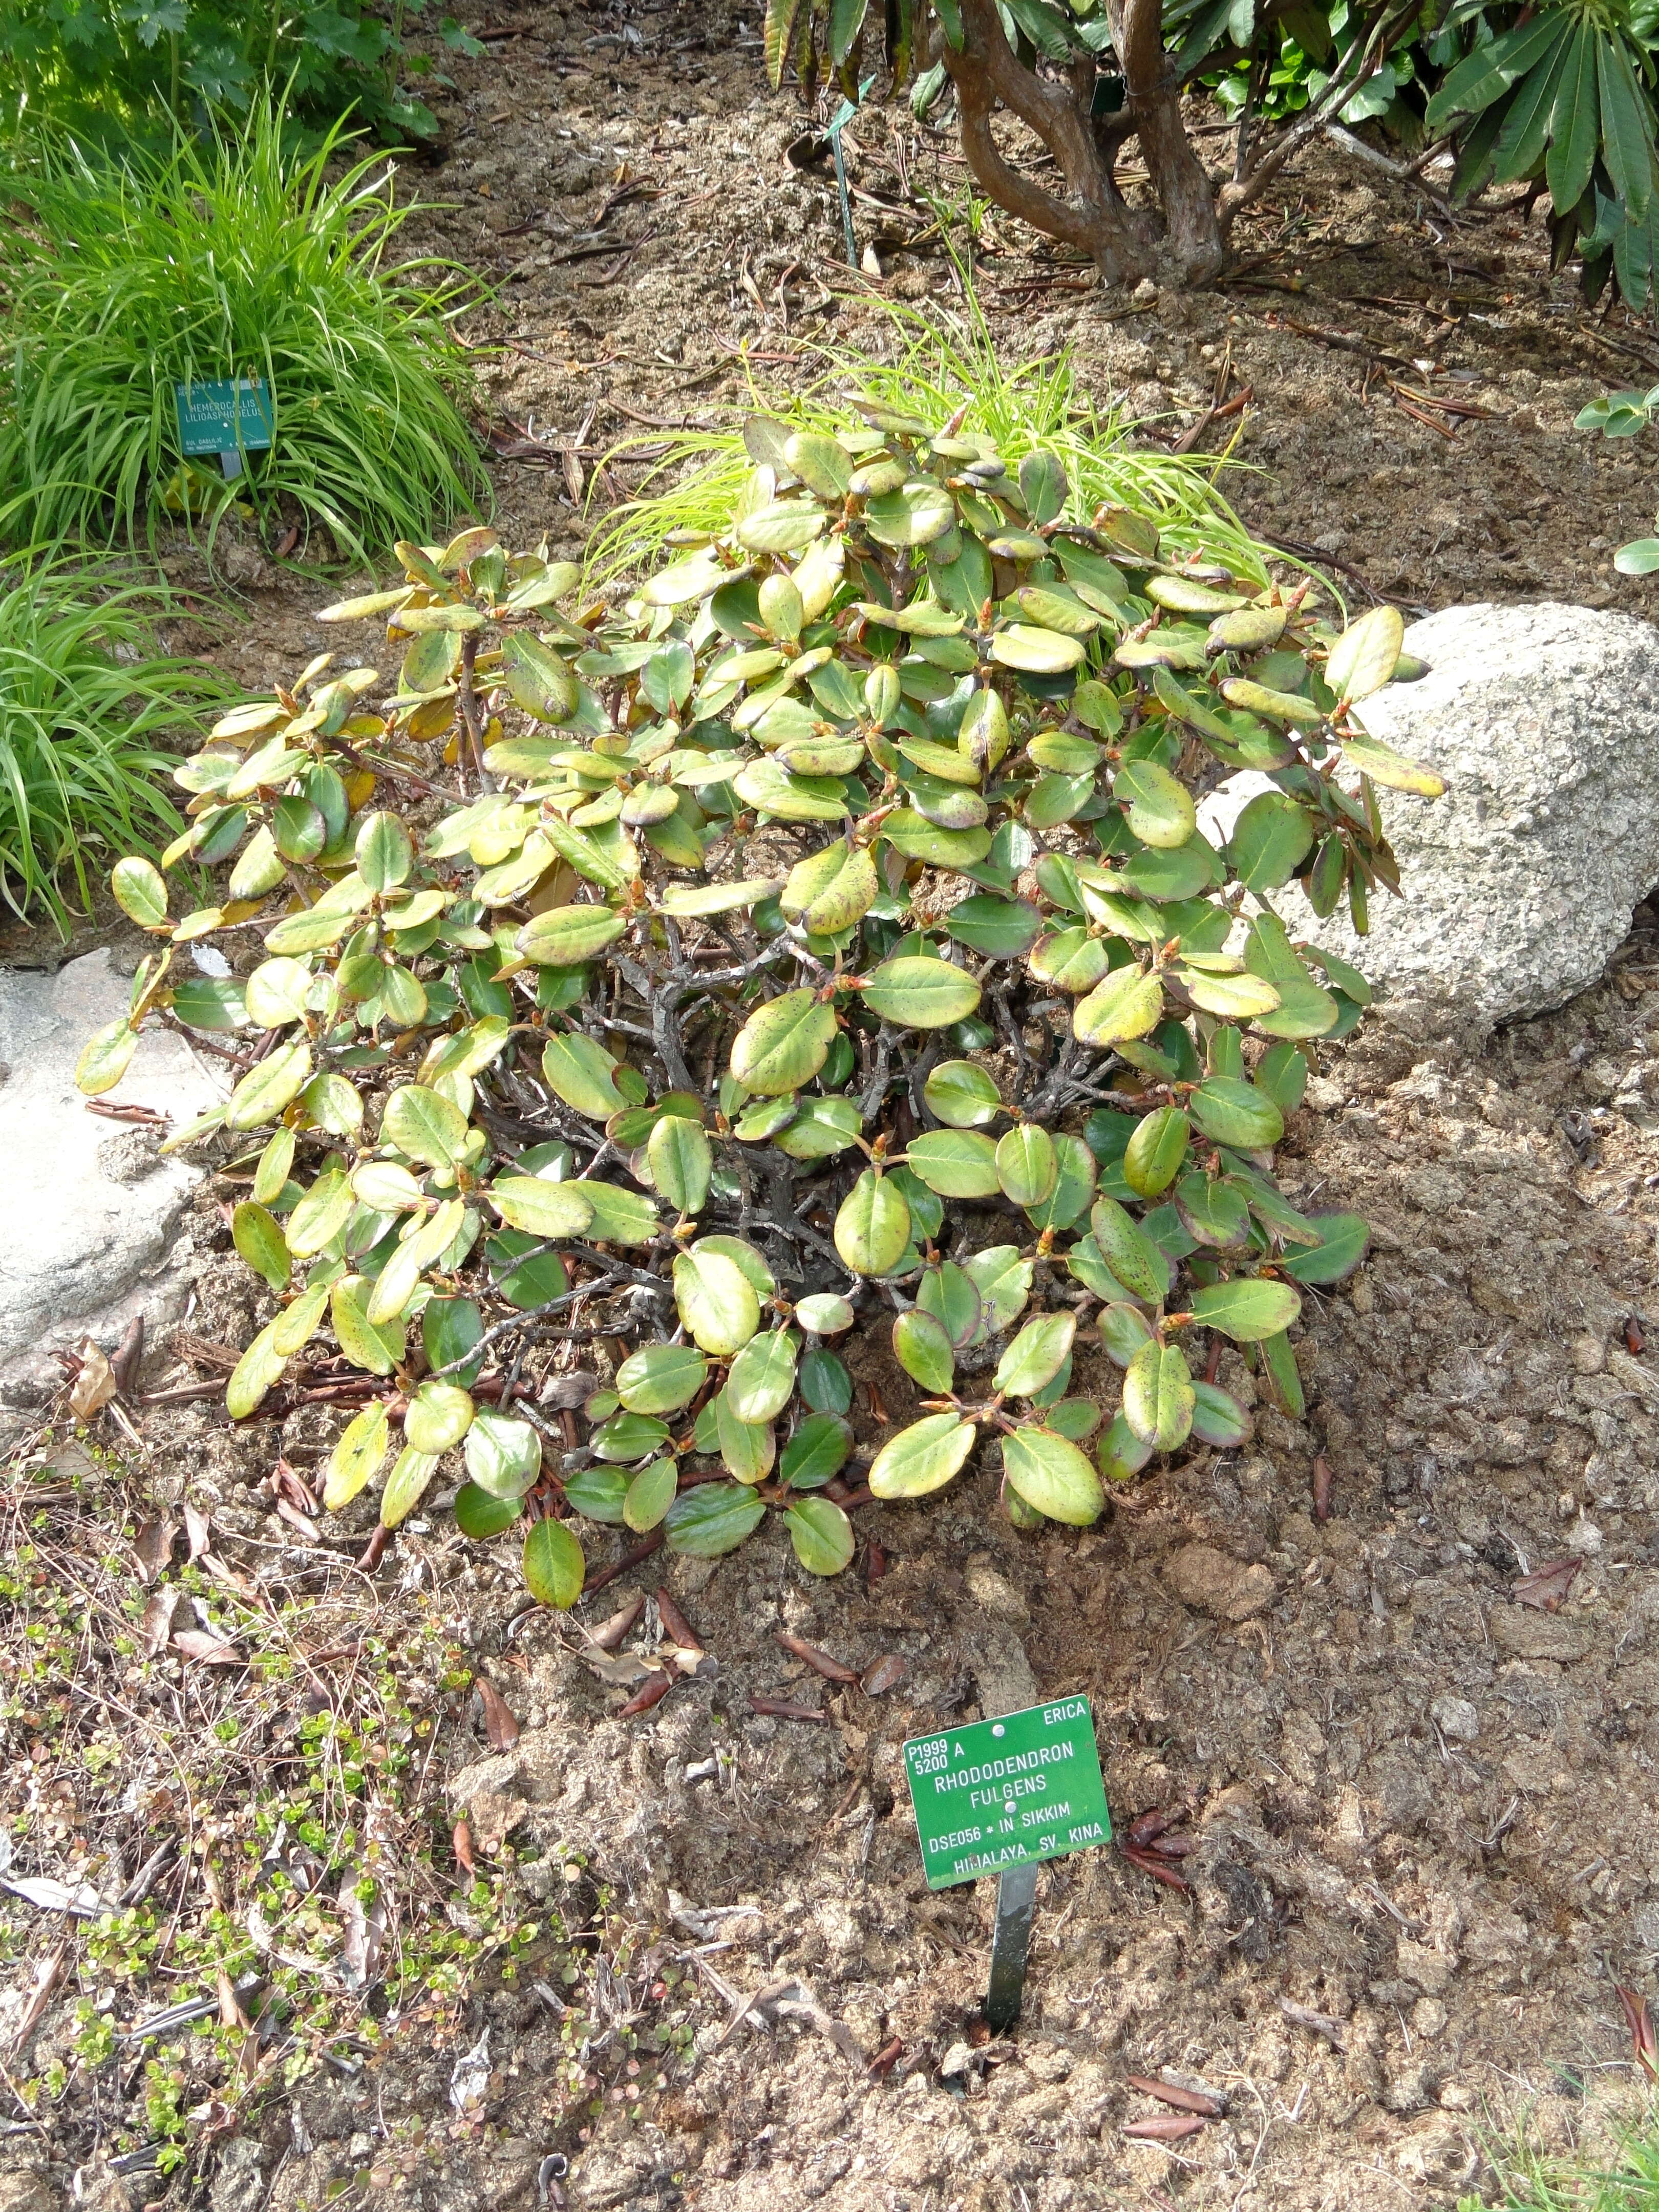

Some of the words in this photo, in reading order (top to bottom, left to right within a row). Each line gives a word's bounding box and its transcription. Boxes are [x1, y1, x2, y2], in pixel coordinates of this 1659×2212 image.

[1043, 1701, 1086, 1725] ERICA
[908, 1739, 948, 1761] P1999
[954, 1742, 965, 1757] A
[915, 1755, 948, 1775] 5200
[934, 1741, 1074, 1793] RHODODENDRON
[970, 1775, 1047, 1809] FULGENS
[929, 1827, 981, 1853] DSE056
[999, 1817, 1014, 1834] IN
[1022, 1801, 1070, 1827] SIKKIM
[1069, 1822, 1103, 1843] KINA
